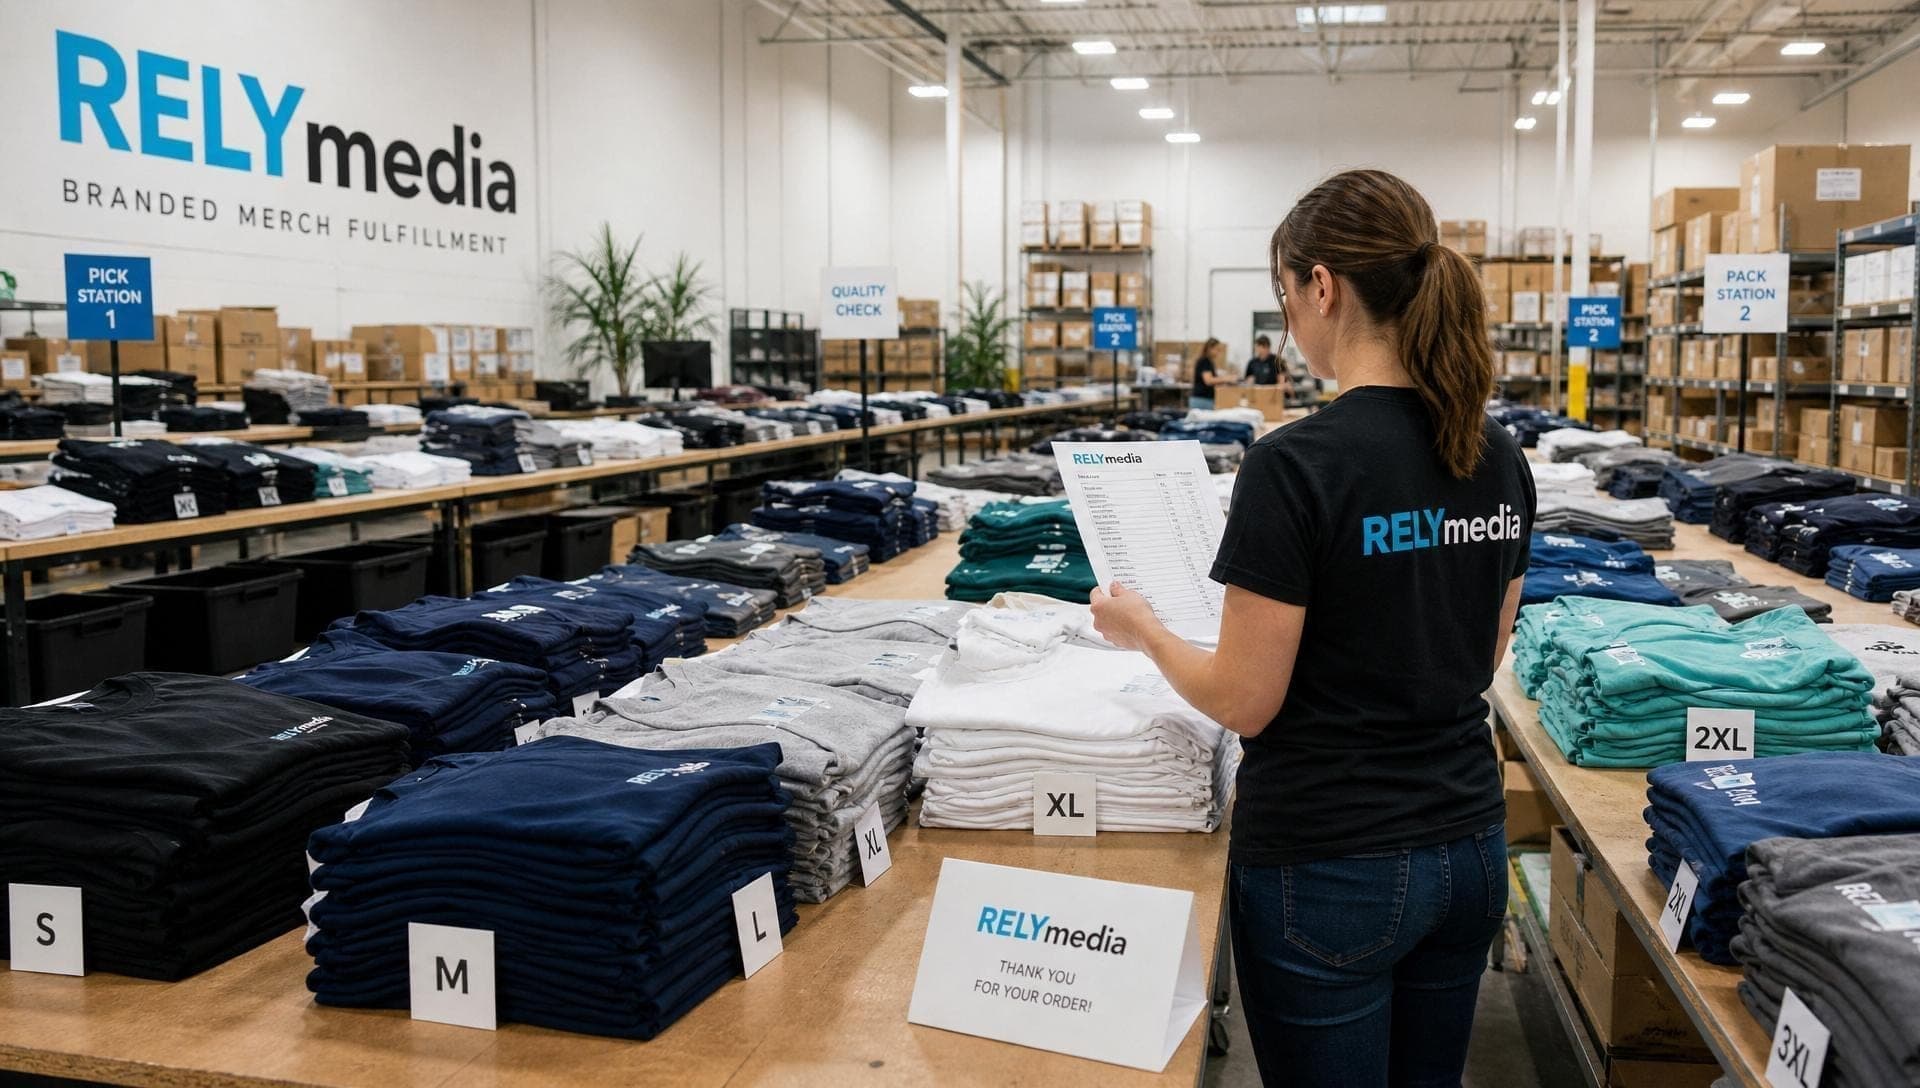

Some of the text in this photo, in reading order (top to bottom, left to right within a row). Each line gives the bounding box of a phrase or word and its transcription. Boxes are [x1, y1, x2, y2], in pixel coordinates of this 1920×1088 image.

[56, 29, 517, 214] RELYmedia
[63, 178, 508, 255] BRANDED MERCH FULFILLMENT
[88, 267, 129, 285] PICK
[1726, 270, 1767, 284] PACK
[77, 288, 142, 304] STATION
[831, 284, 887, 299] QUALITY
[1717, 287, 1776, 301] STATION
[105, 309, 116, 329] 1
[835, 302, 883, 317] CHECK
[1573, 316, 1616, 327] STATION
[1580, 304, 1609, 315] PICK
[1739, 305, 1751, 321] 2
[1111, 333, 1120, 346] 2
[1588, 328, 1599, 342] 2
[1073, 452, 1143, 465] RELYmedia
[1362, 503, 1522, 556] RELYmedia
[1693, 726, 1748, 752] 2XL
[1046, 792, 1085, 818] XL
[864, 826, 883, 860] XL
[1667, 881, 1688, 925] 2XL
[36, 912, 56, 947] S
[752, 910, 768, 943] L
[976, 906, 1128, 957] RELYmedia
[435, 955, 469, 995] M
[999, 959, 1076, 986] THANK YOU
[973, 978, 1093, 1013] FOR YOUR ORDER!
[1777, 1023, 1811, 1088] 3XL
